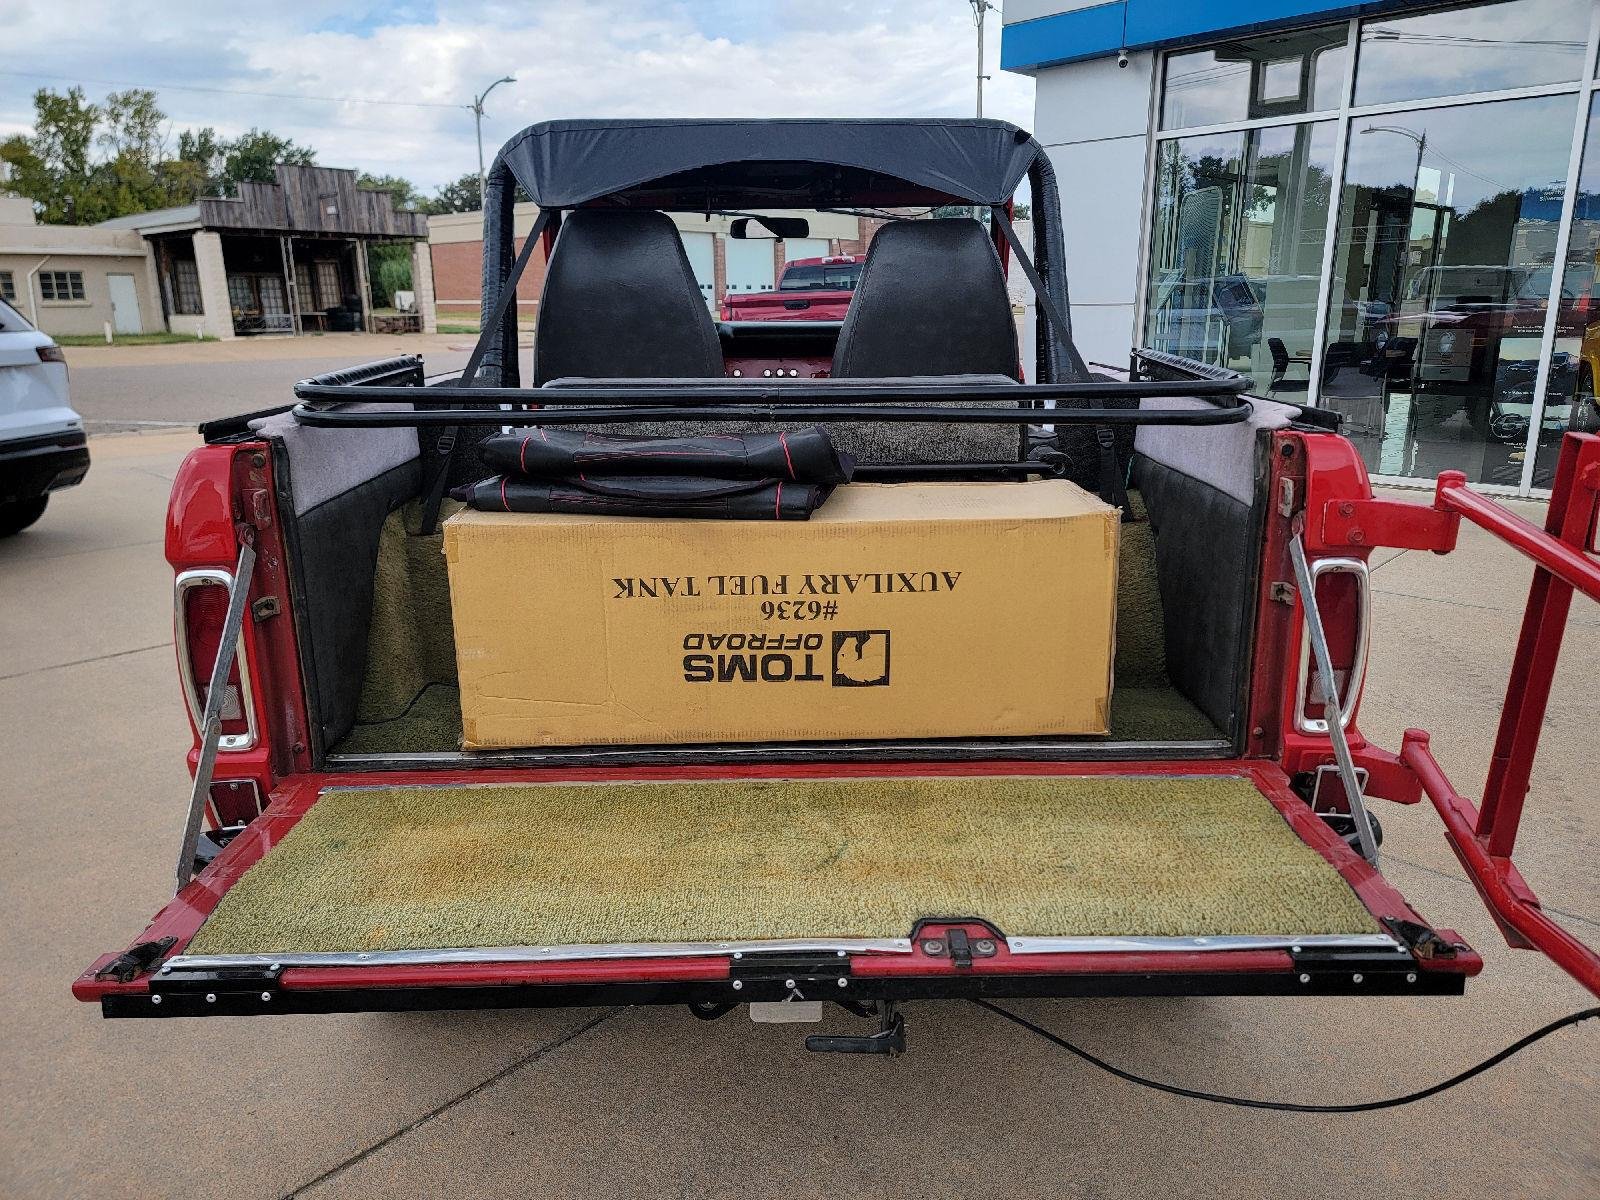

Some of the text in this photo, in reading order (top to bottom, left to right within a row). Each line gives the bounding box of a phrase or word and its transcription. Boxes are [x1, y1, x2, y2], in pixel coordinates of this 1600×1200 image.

[612, 571, 963, 599] AUXILARY FUEL TANK
[760, 600, 839, 621] #6236
[682, 633, 824, 651] OFFROAD
[682, 653, 825, 683] TOMS
